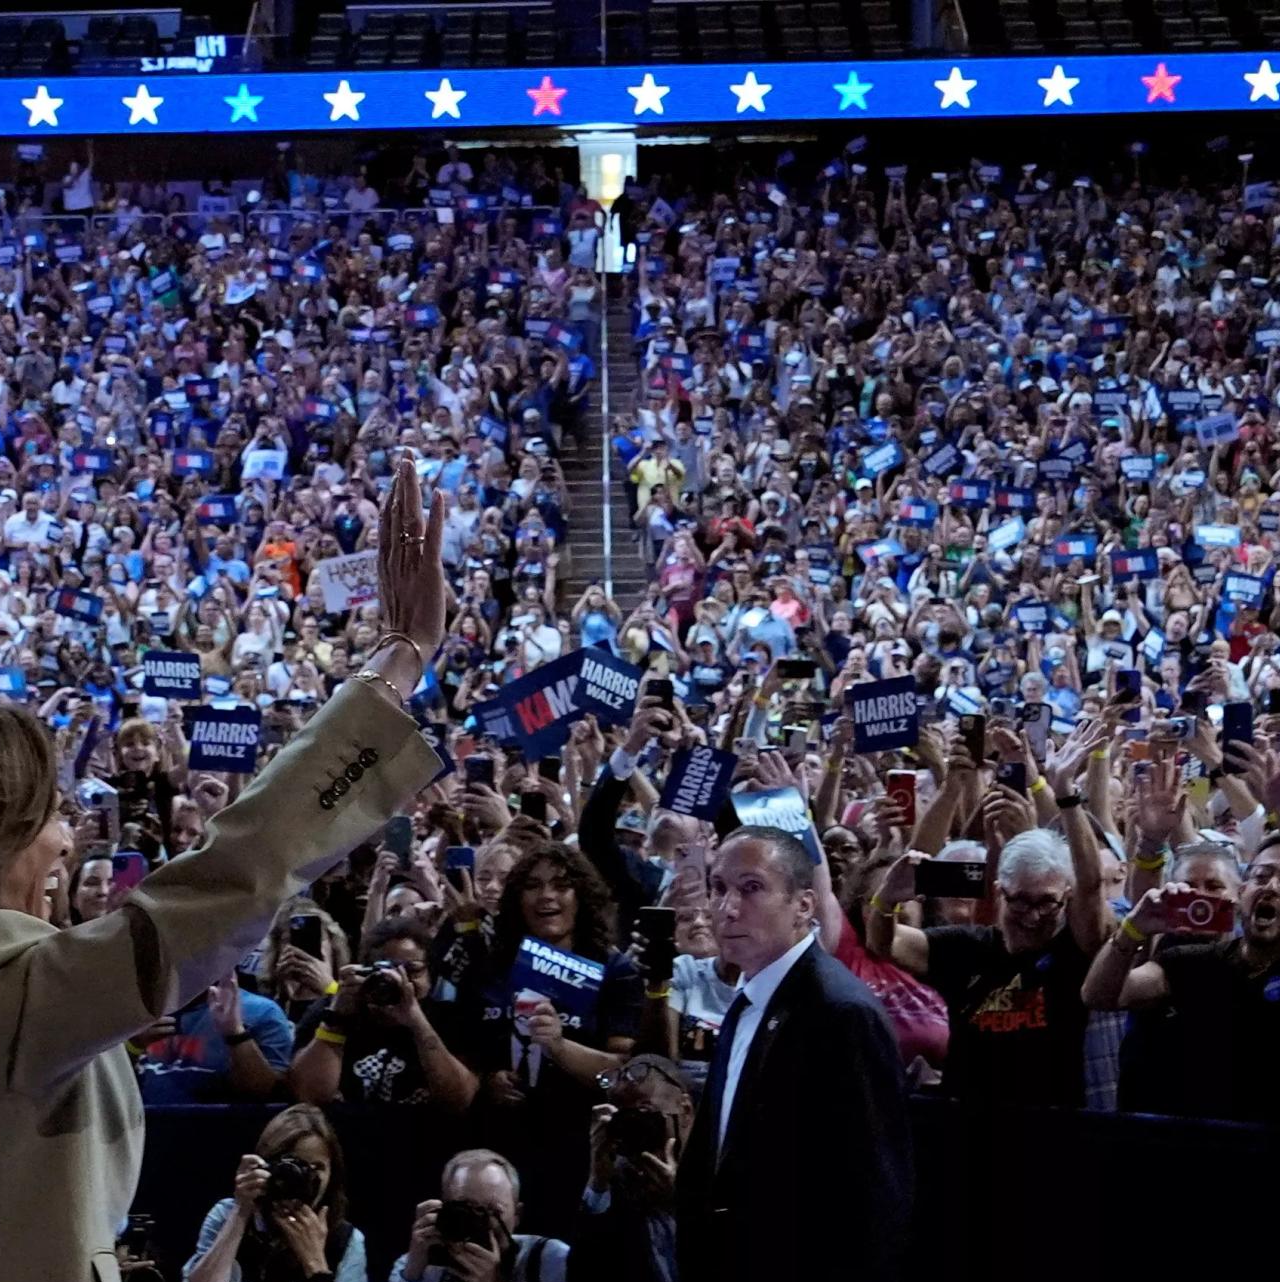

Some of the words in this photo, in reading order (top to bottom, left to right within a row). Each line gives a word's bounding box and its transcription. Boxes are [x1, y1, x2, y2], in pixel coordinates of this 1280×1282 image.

[327, 558, 377, 583] HARRI
[144, 660, 200, 679] HARRIS
[154, 677, 193, 689] WALZ
[580, 657, 638, 701] HARRIS
[515, 674, 579, 735] KAM
[585, 683, 625, 710] WALZ
[854, 691, 917, 724] HARRIS
[192, 720, 259, 744] HARRIS
[865, 718, 908, 738] WALZ
[201, 743, 246, 758] WALZ
[672, 745, 714, 814] HARRIS
[696, 760, 722, 806] WALZ
[521, 938, 603, 982] HARRIS
[531, 956, 587, 988] WALZ
[561, 1014, 583, 1030] 24
